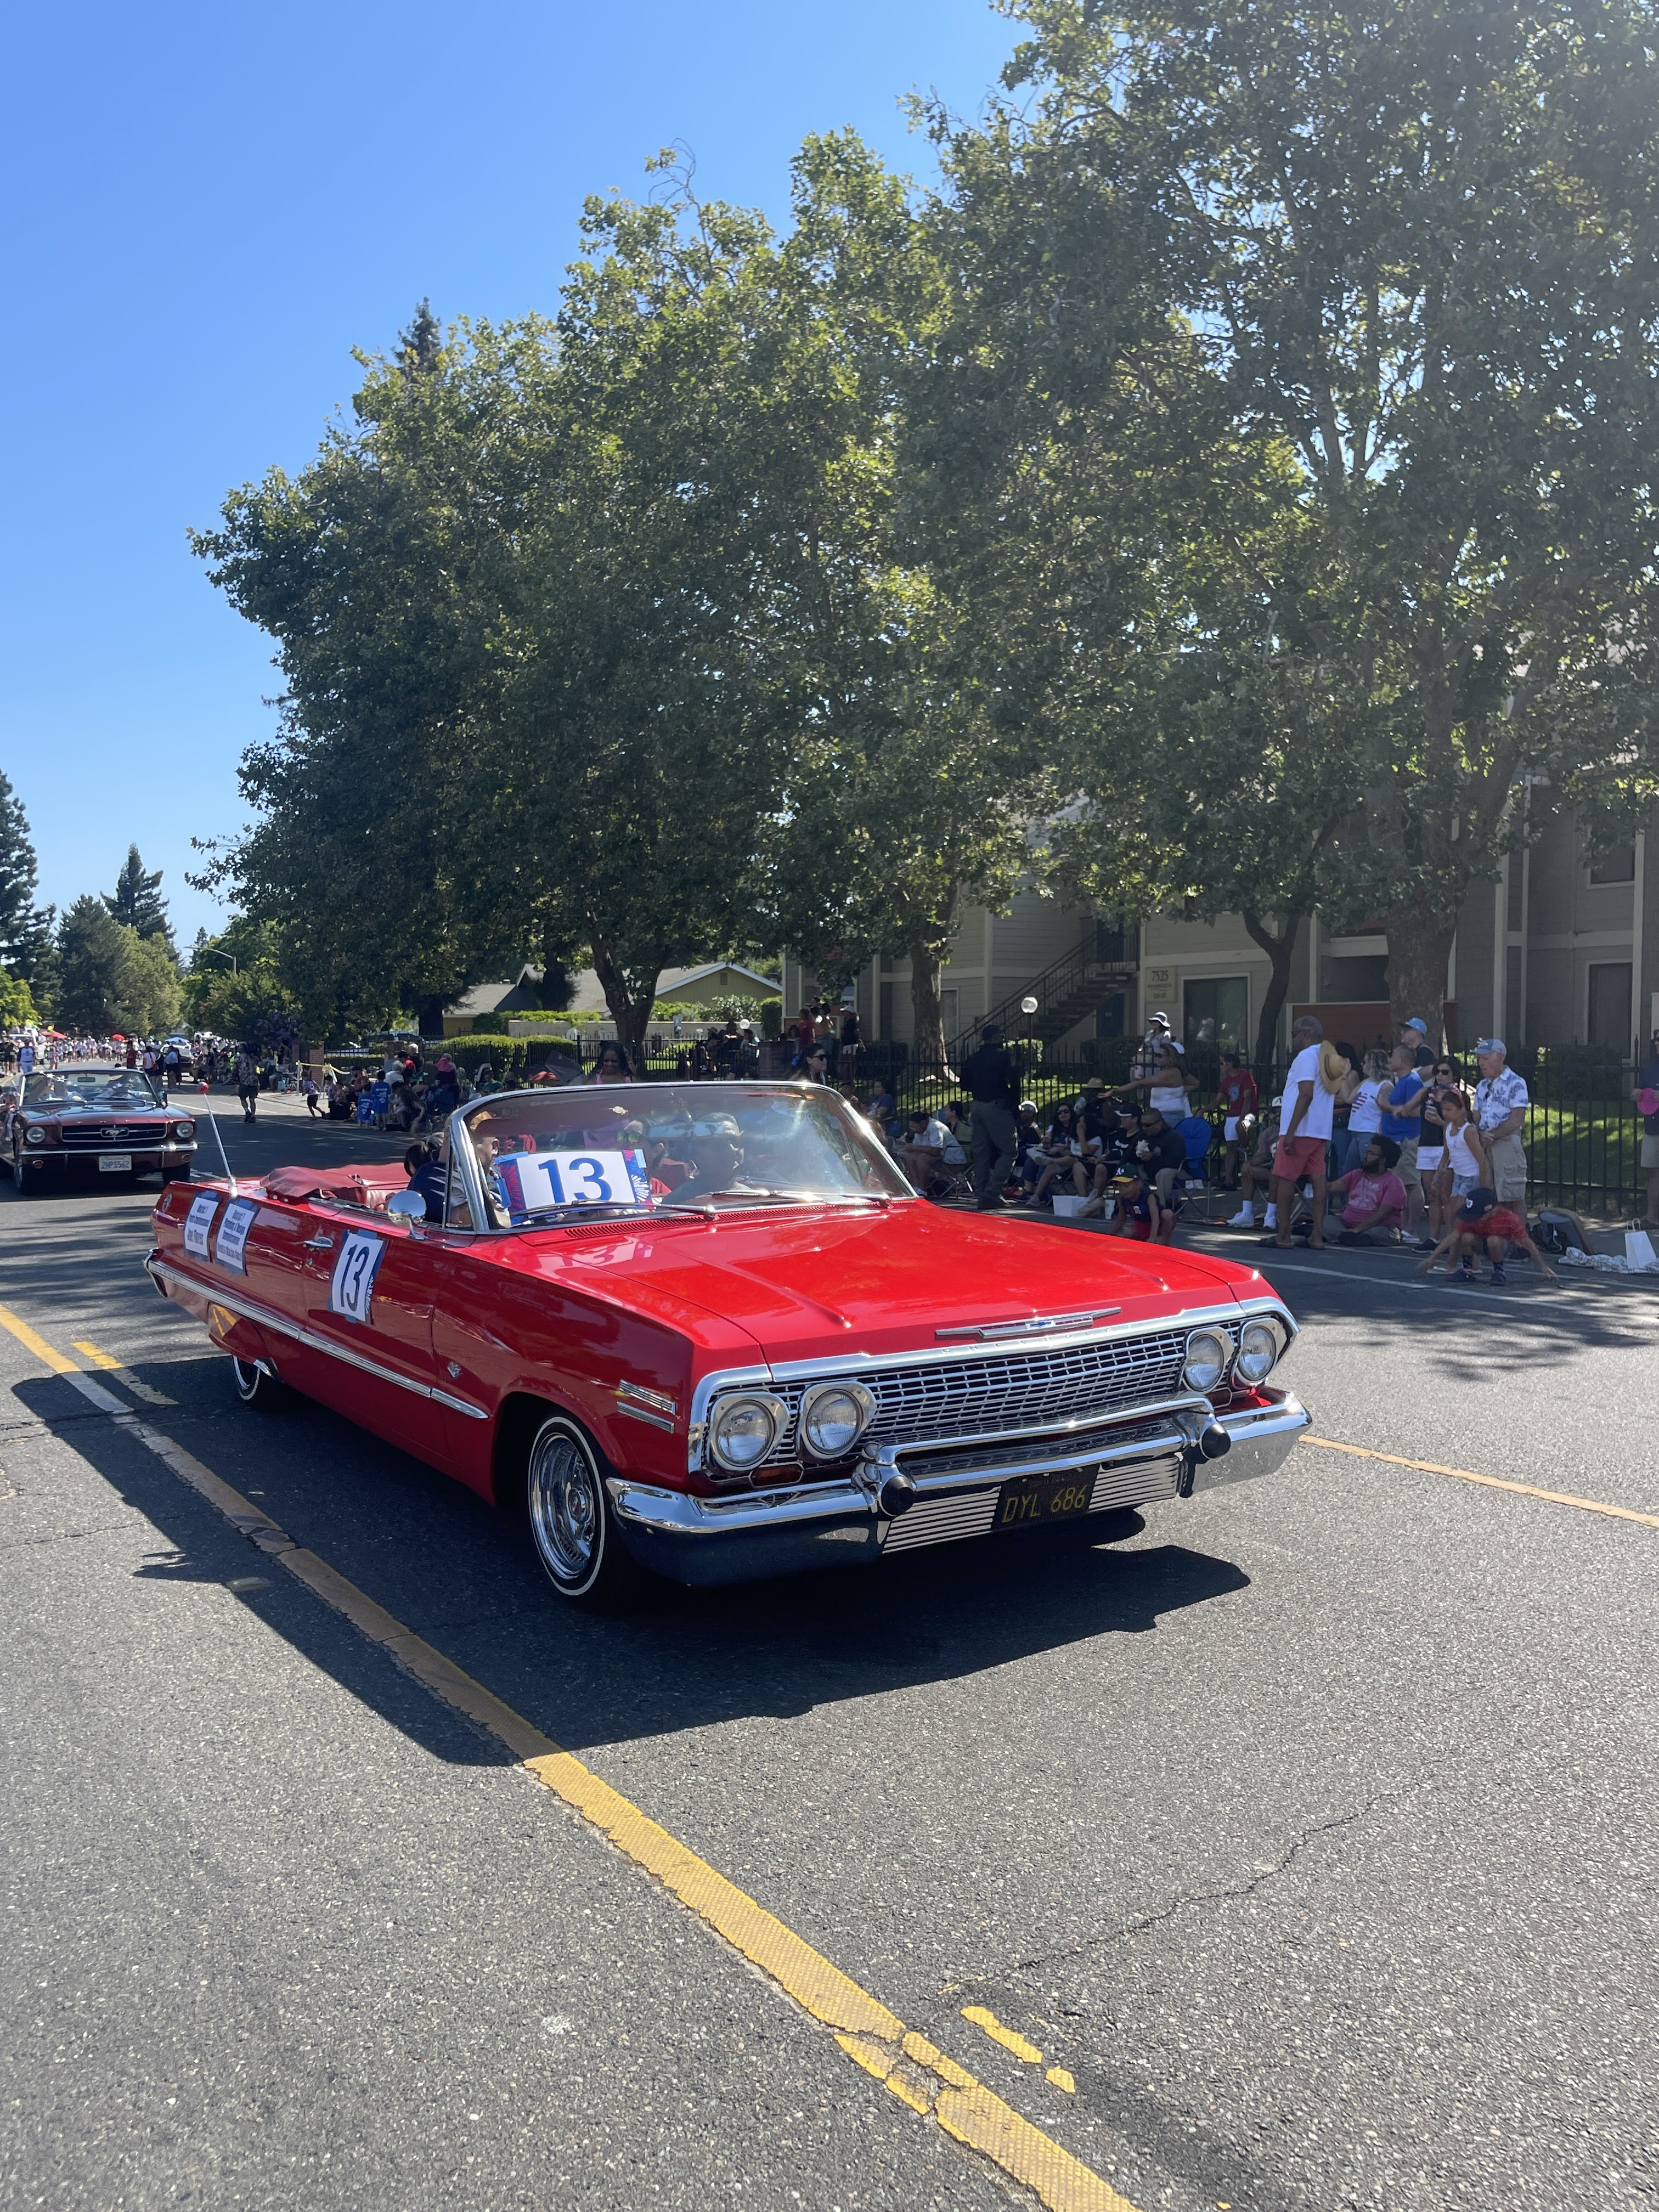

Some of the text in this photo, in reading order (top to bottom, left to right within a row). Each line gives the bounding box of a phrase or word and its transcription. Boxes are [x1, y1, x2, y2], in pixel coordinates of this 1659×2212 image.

[538, 1158, 612, 1204] 13
[340, 1244, 370, 1312] 13
[1002, 1484, 1088, 1523] DYL 686
